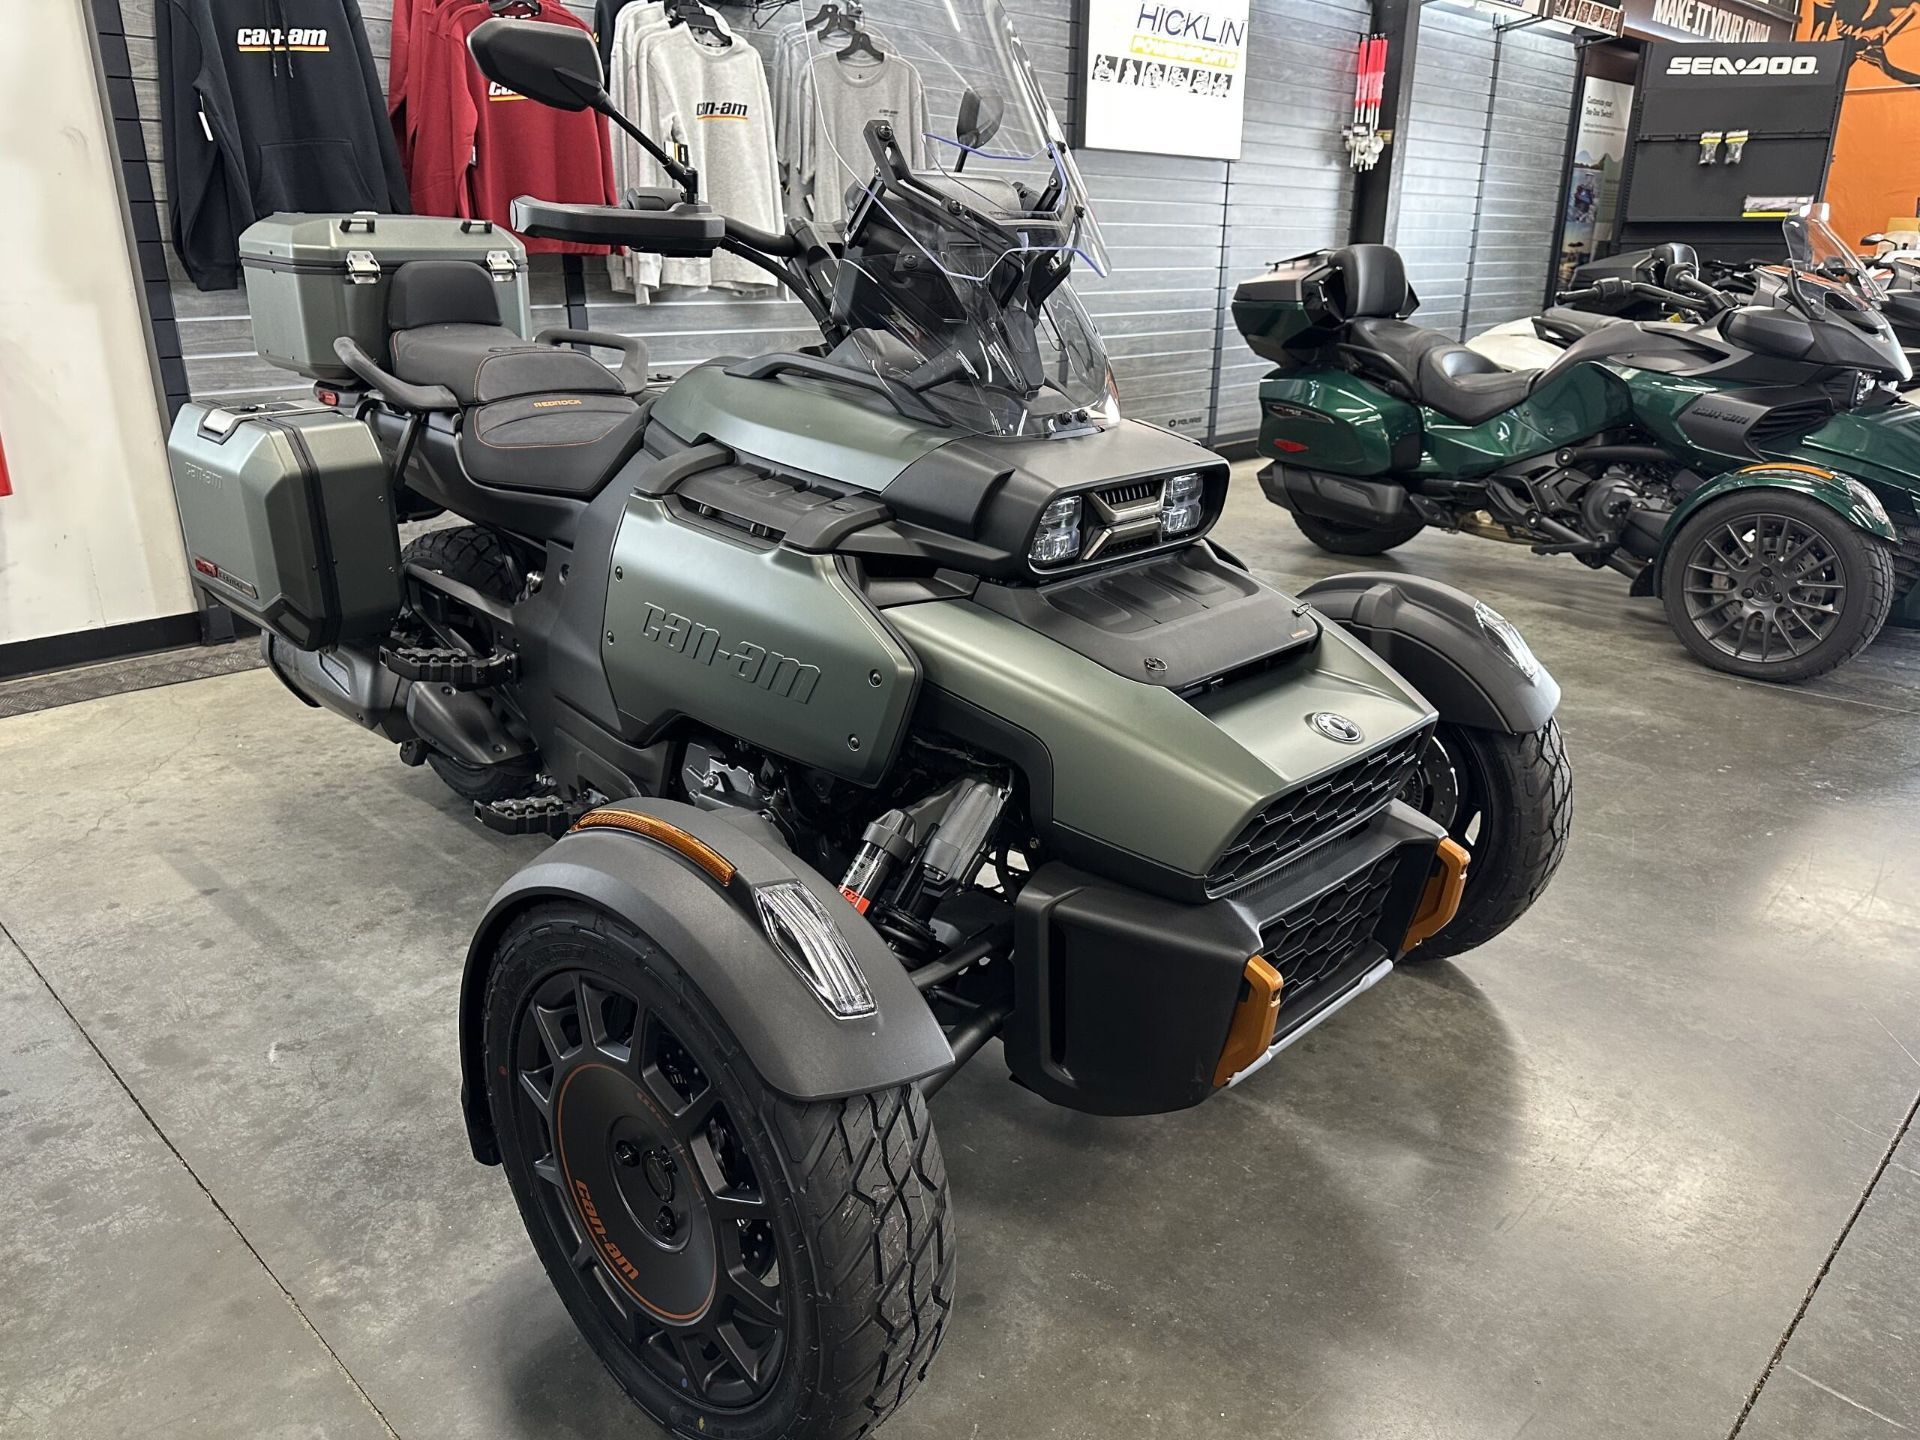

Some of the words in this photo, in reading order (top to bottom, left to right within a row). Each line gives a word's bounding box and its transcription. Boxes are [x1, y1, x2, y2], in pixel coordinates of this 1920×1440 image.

[237, 28, 327, 46] can-am
[1136, 3, 1245, 46] HICKLIN
[1652, 0, 1695, 32] MAKE
[1691, 3, 1712, 37] IT
[1709, 7, 1744, 44] YOUR
[1692, 407, 1750, 425] can-am
[641, 601, 822, 704] can-am
[575, 1179, 640, 1281] can-am
